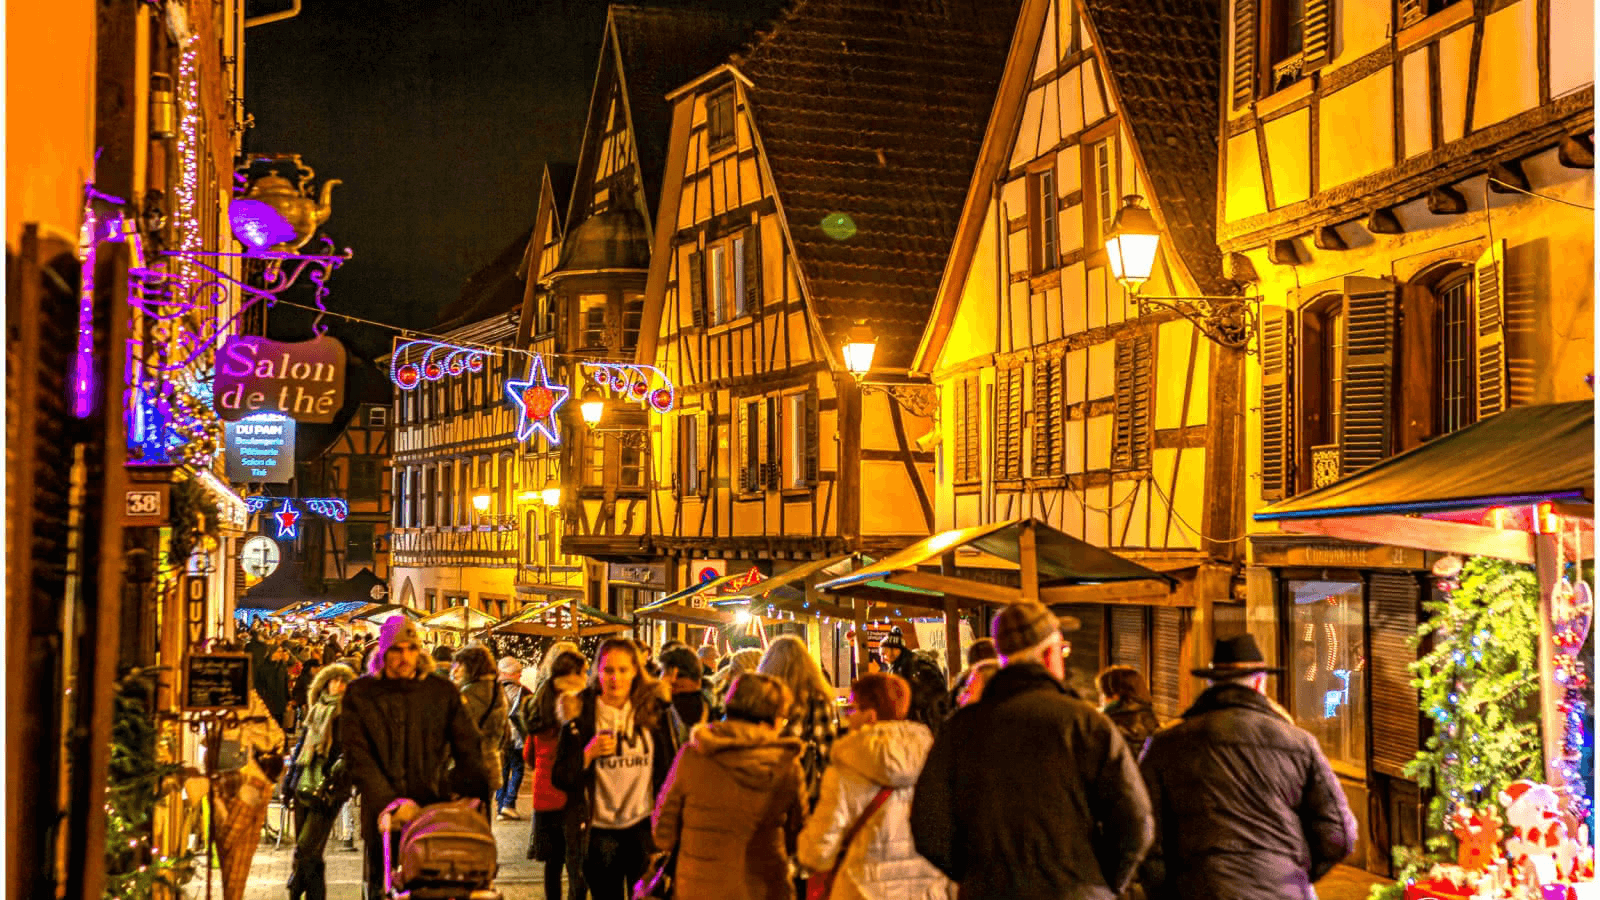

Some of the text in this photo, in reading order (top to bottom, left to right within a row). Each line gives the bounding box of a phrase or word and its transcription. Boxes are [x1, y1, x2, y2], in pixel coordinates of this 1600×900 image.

[222, 343, 335, 382] Salon
[221, 384, 336, 414] de thé
[236, 425, 283, 435] DU PAIN
[129, 494, 156, 513] 38
